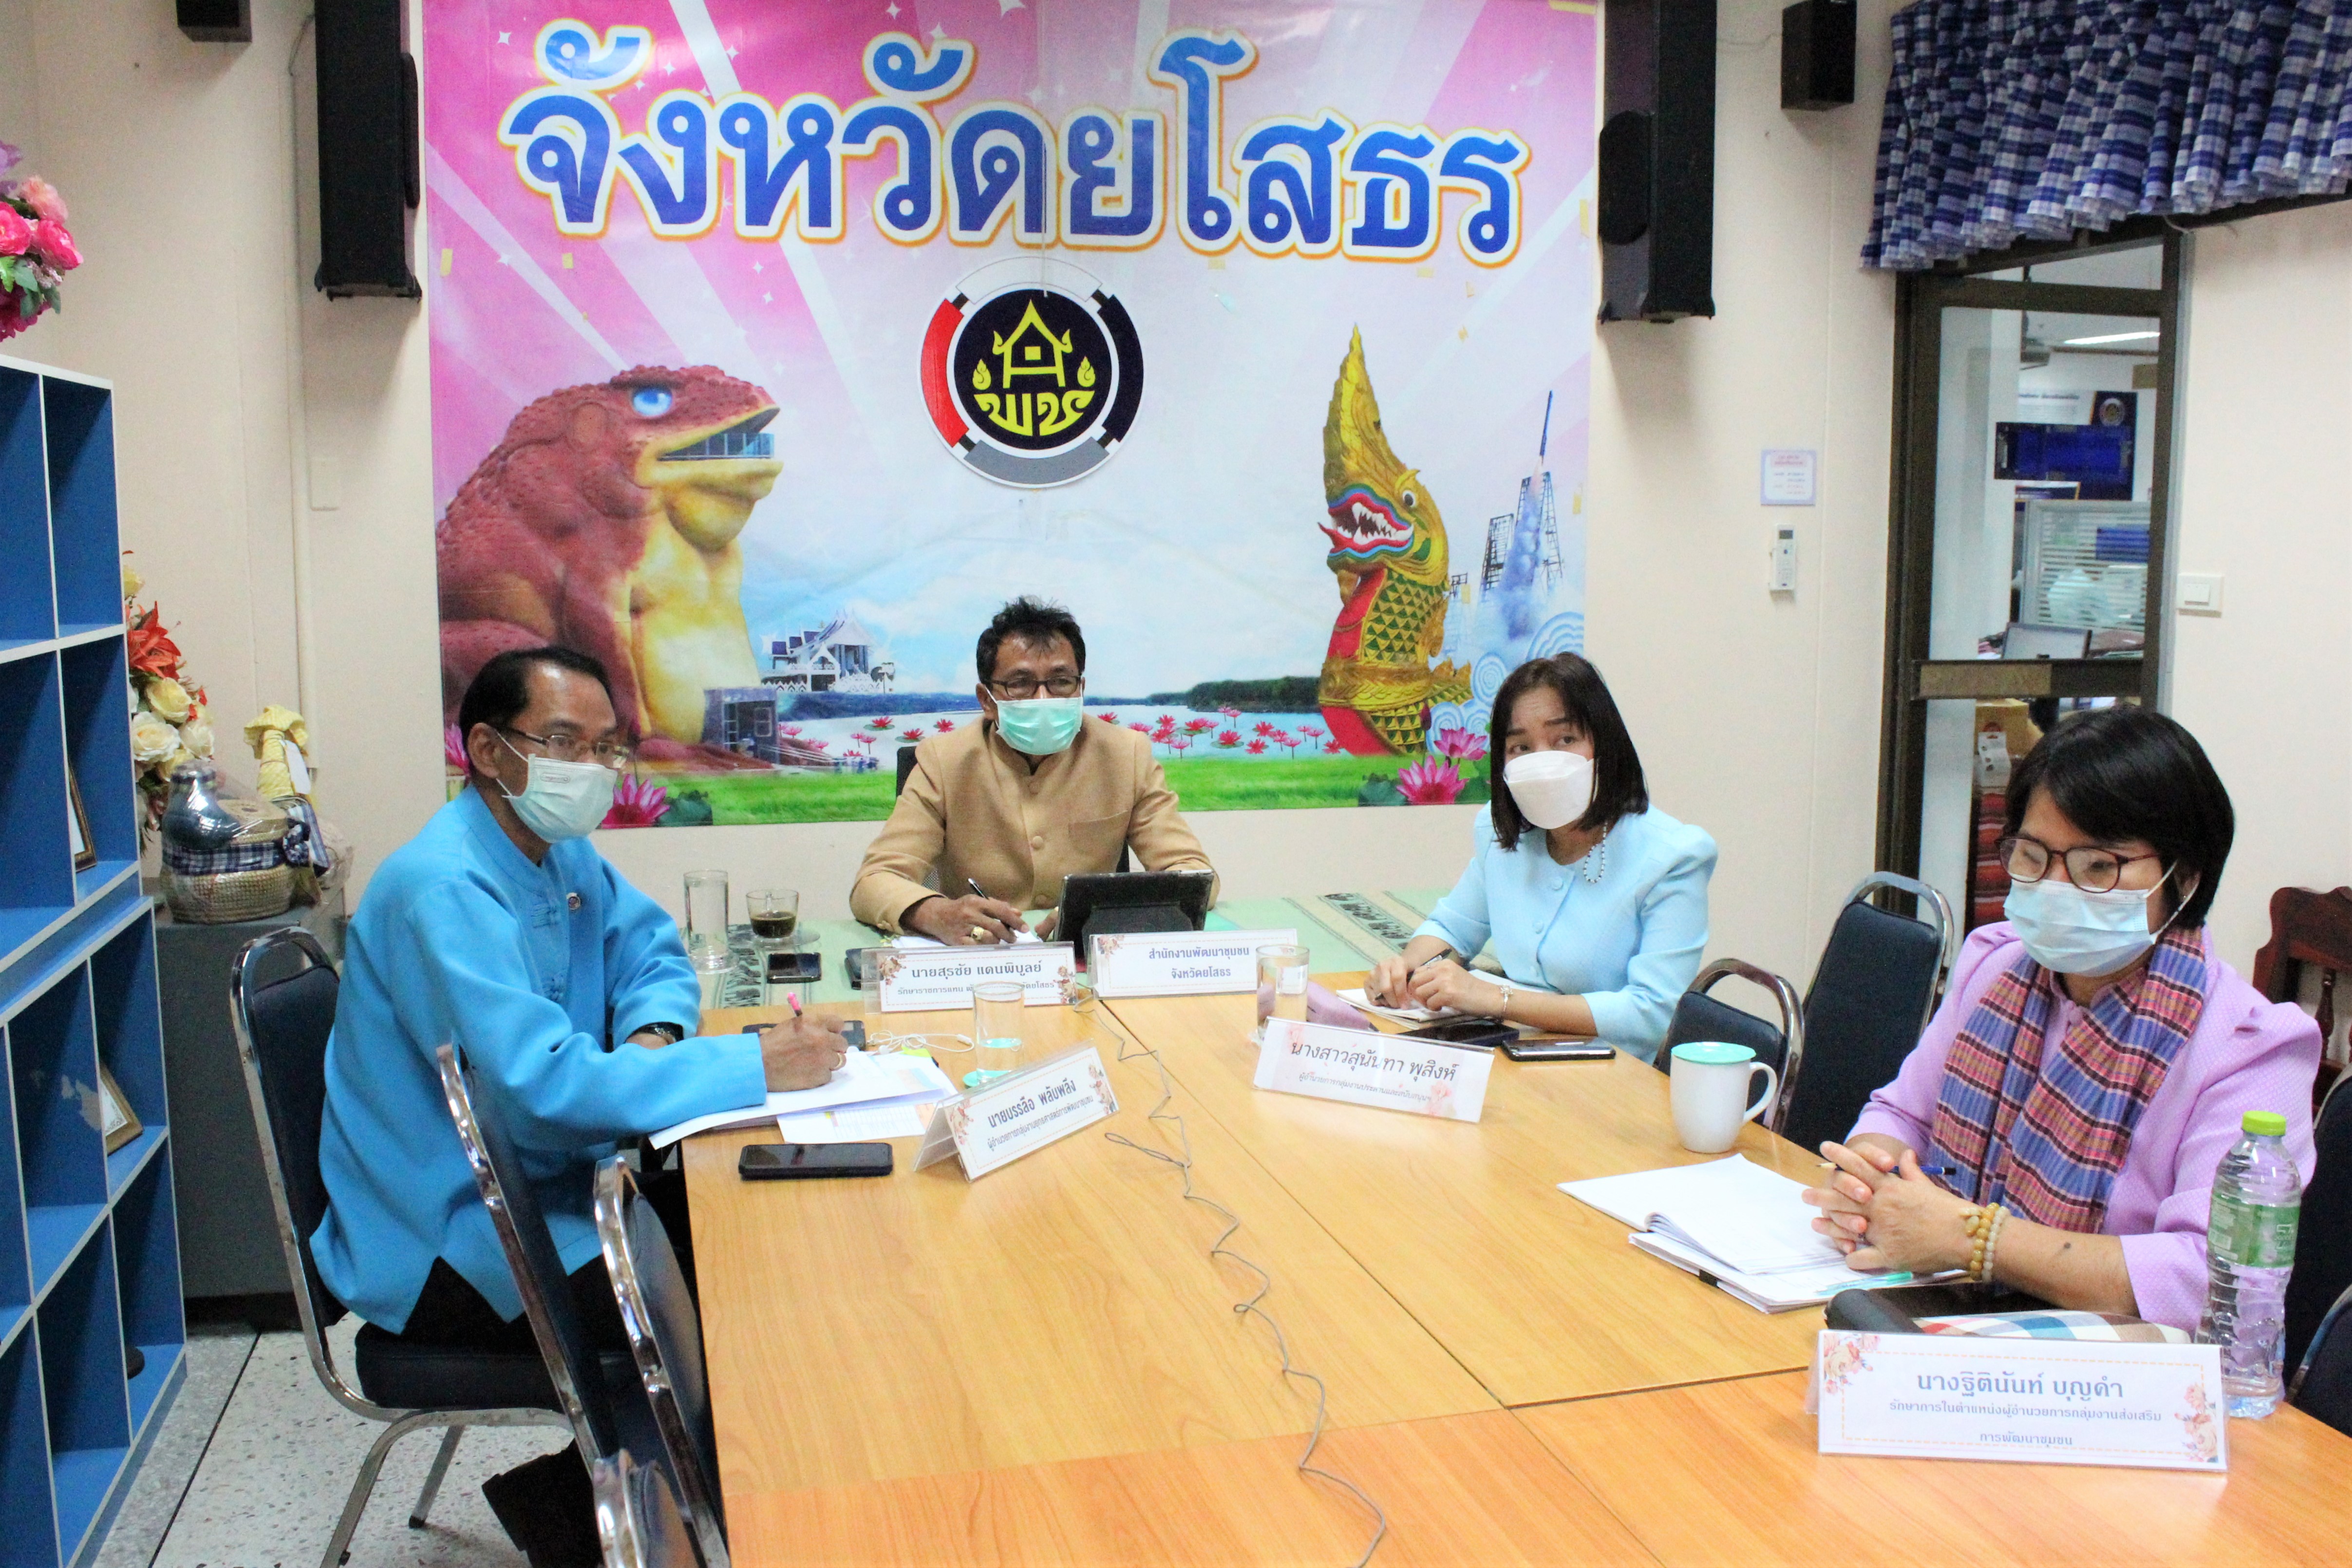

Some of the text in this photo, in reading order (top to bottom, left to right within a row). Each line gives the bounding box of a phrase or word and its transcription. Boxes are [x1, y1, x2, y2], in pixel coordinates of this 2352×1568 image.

[508, 27, 1521, 256] จังหวัดยโสธร
[1148, 946, 1250, 960] สำนักงานพัฒนาชุมชน
[912, 960, 1042, 980] นายสุรชัย แดนพิบูลย์
[1171, 967, 1231, 980] จังหวัดยโสธร
[1291, 1041, 1460, 1082] นางสาวสุนันทา พุสิงห์
[988, 1096, 1035, 1128] นายบรรลือ
[1917, 1371, 2124, 1402] นางฐิตินันท์ บุญคำ
[1979, 1430, 2073, 1448] การพัฒนาชุมชน
